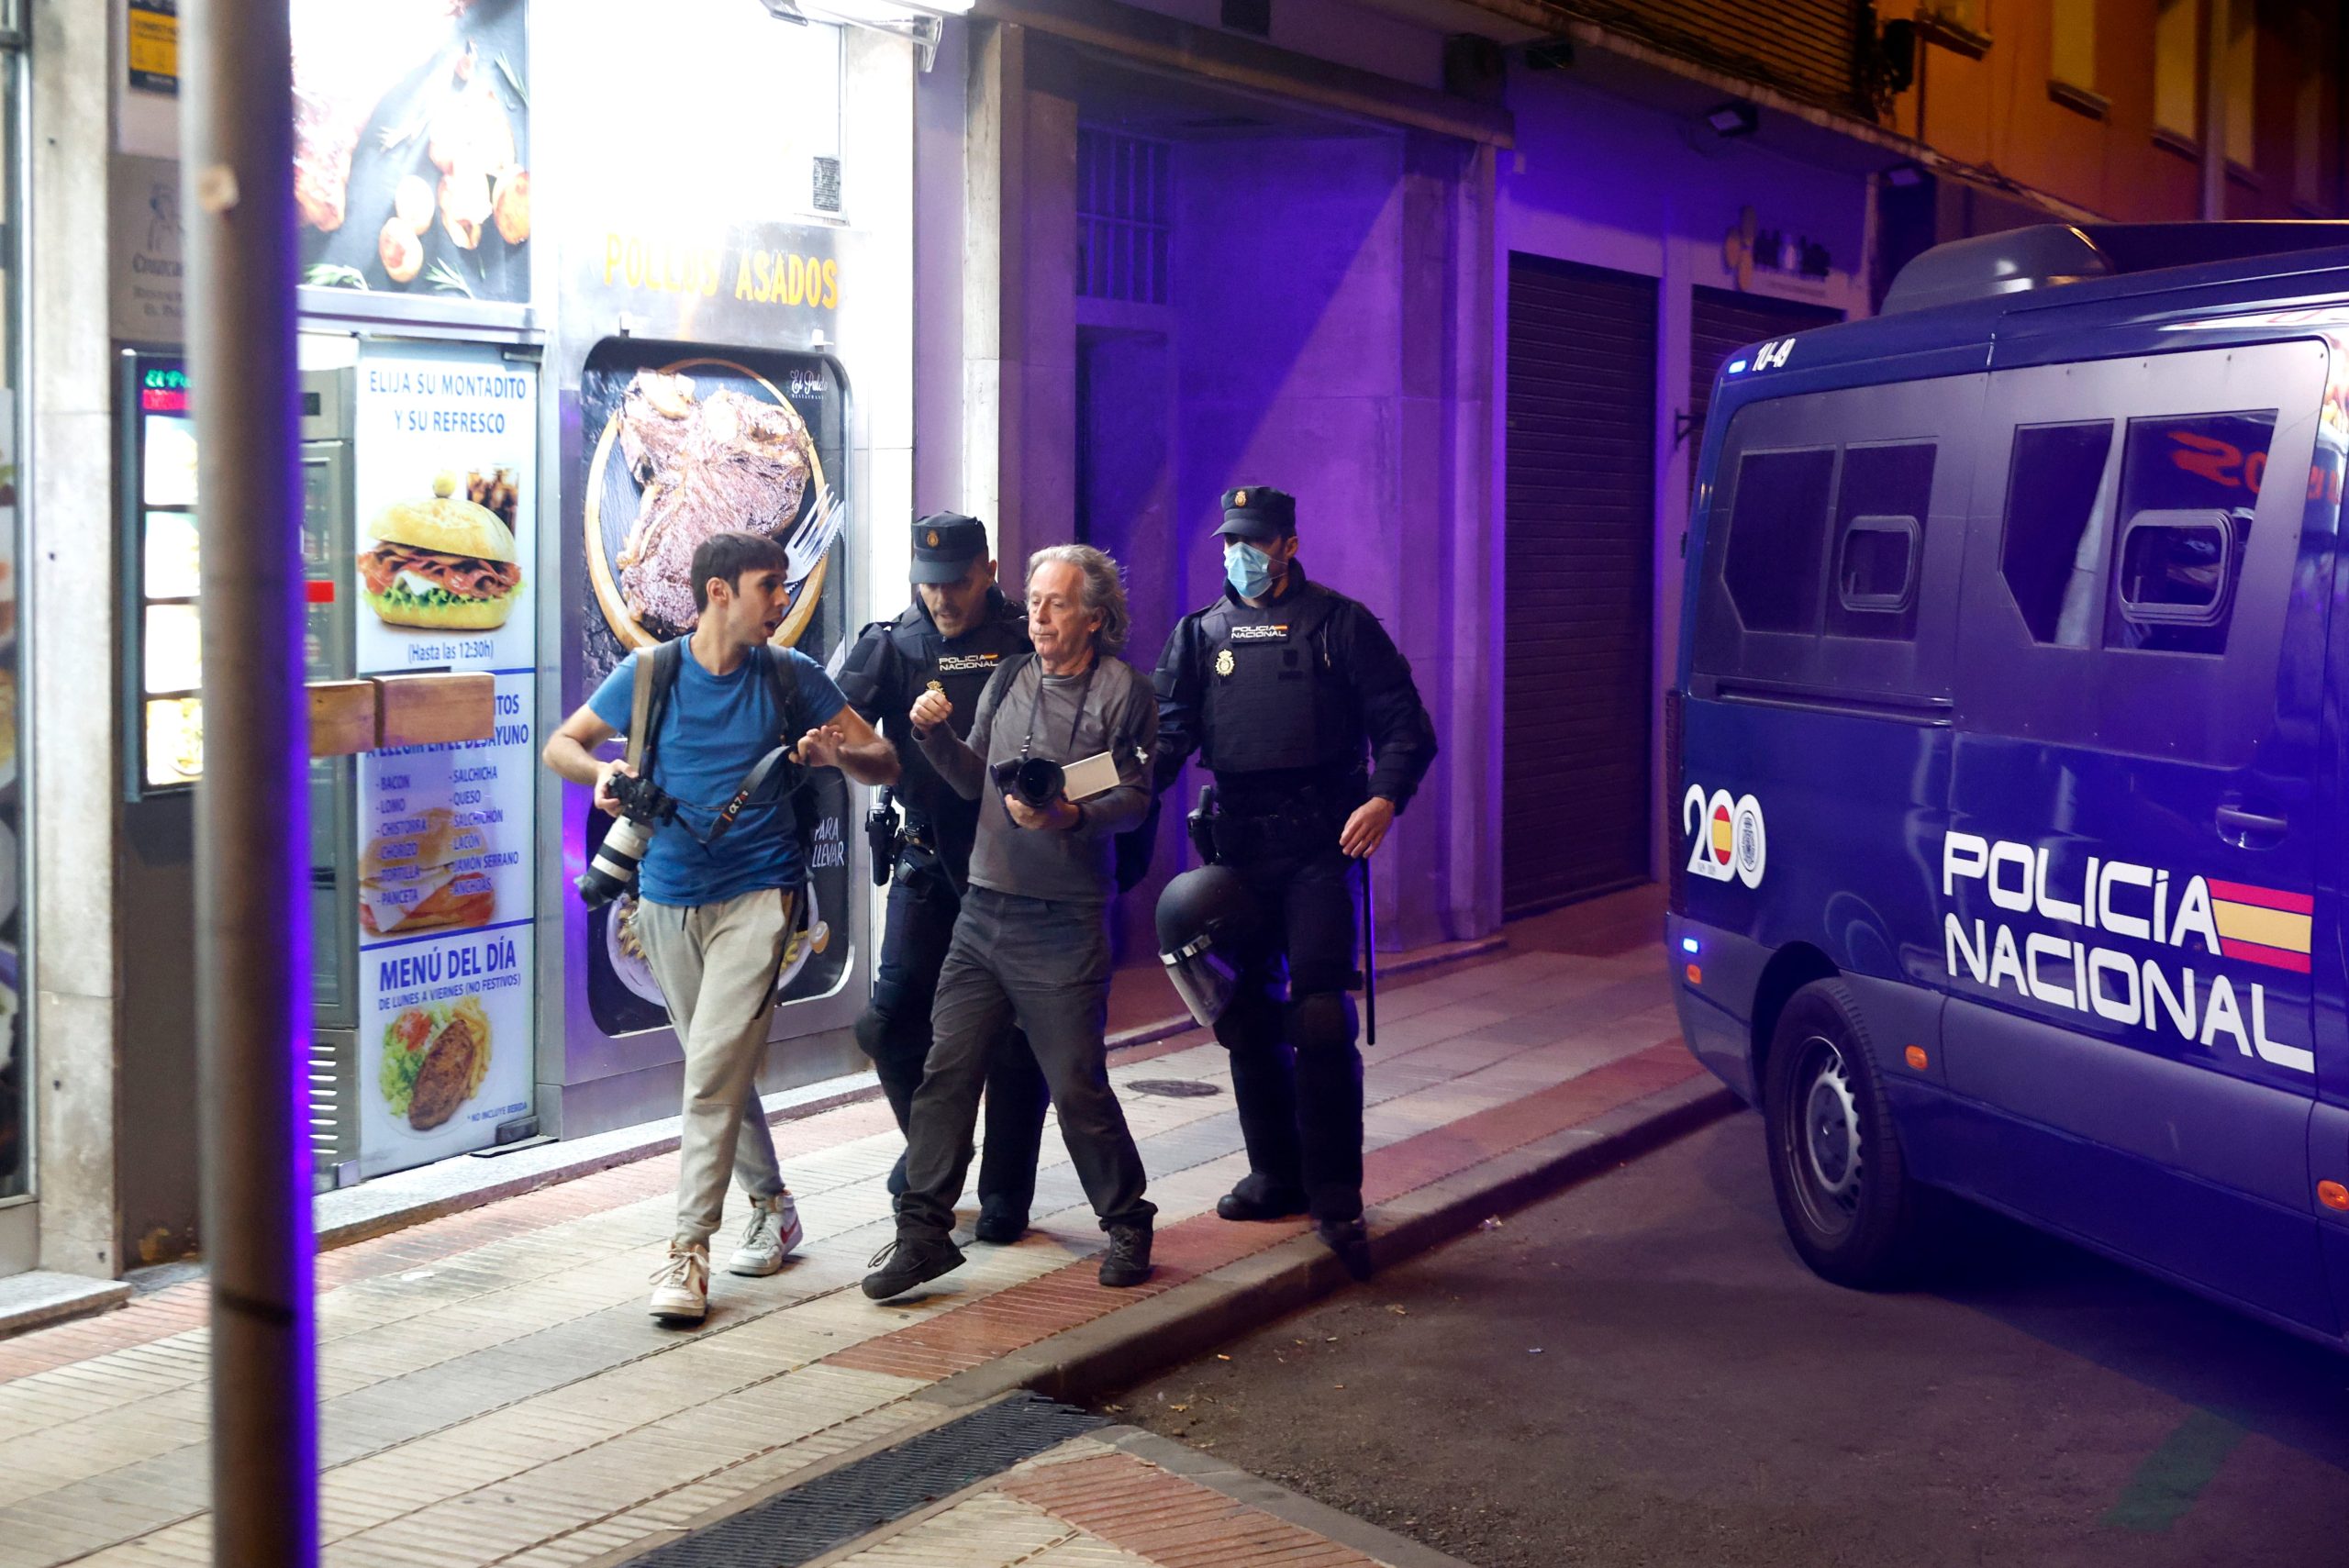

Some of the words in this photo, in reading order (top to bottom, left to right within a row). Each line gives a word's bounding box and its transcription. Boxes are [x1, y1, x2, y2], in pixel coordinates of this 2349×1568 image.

[734, 250, 838, 309] ASADOS
[370, 371, 411, 393] ELIJA
[417, 373, 436, 395] SU
[441, 374, 527, 399] MONTADITO
[395, 409, 403, 429] Y
[408, 410, 428, 431] SU
[433, 411, 506, 434] REFRESCO
[1231, 630, 1286, 639] NACIONAL
[407, 642, 440, 663] (Hasta
[443, 641, 456, 659] las
[460, 639, 495, 661] 12:30h)
[940, 661, 999, 671] NACIONAL
[381, 773, 411, 791] BACON
[453, 765, 498, 784] SALCHICHA
[381, 798, 406, 814] LOMO
[453, 789, 481, 806] QUESO
[814, 816, 840, 841] PARA
[1684, 783, 1766, 890] 200
[381, 842, 418, 860] CHORIZO
[484, 851, 519, 869] SERRANO
[812, 840, 845, 868] LLEVAR
[381, 888, 418, 906] PANCETA
[380, 946, 441, 992] MENÚ
[448, 946, 482, 980] DEL
[486, 936, 517, 973] DÍA
[379, 998, 390, 1011] DE
[393, 992, 420, 1007] LUNES
[421, 991, 429, 1003] A
[429, 984, 463, 1001] VIERNES
[465, 981, 481, 995] (NO
[483, 973, 521, 992] FESTIVOS)
[1943, 912, 2315, 1073] NACIONAL
